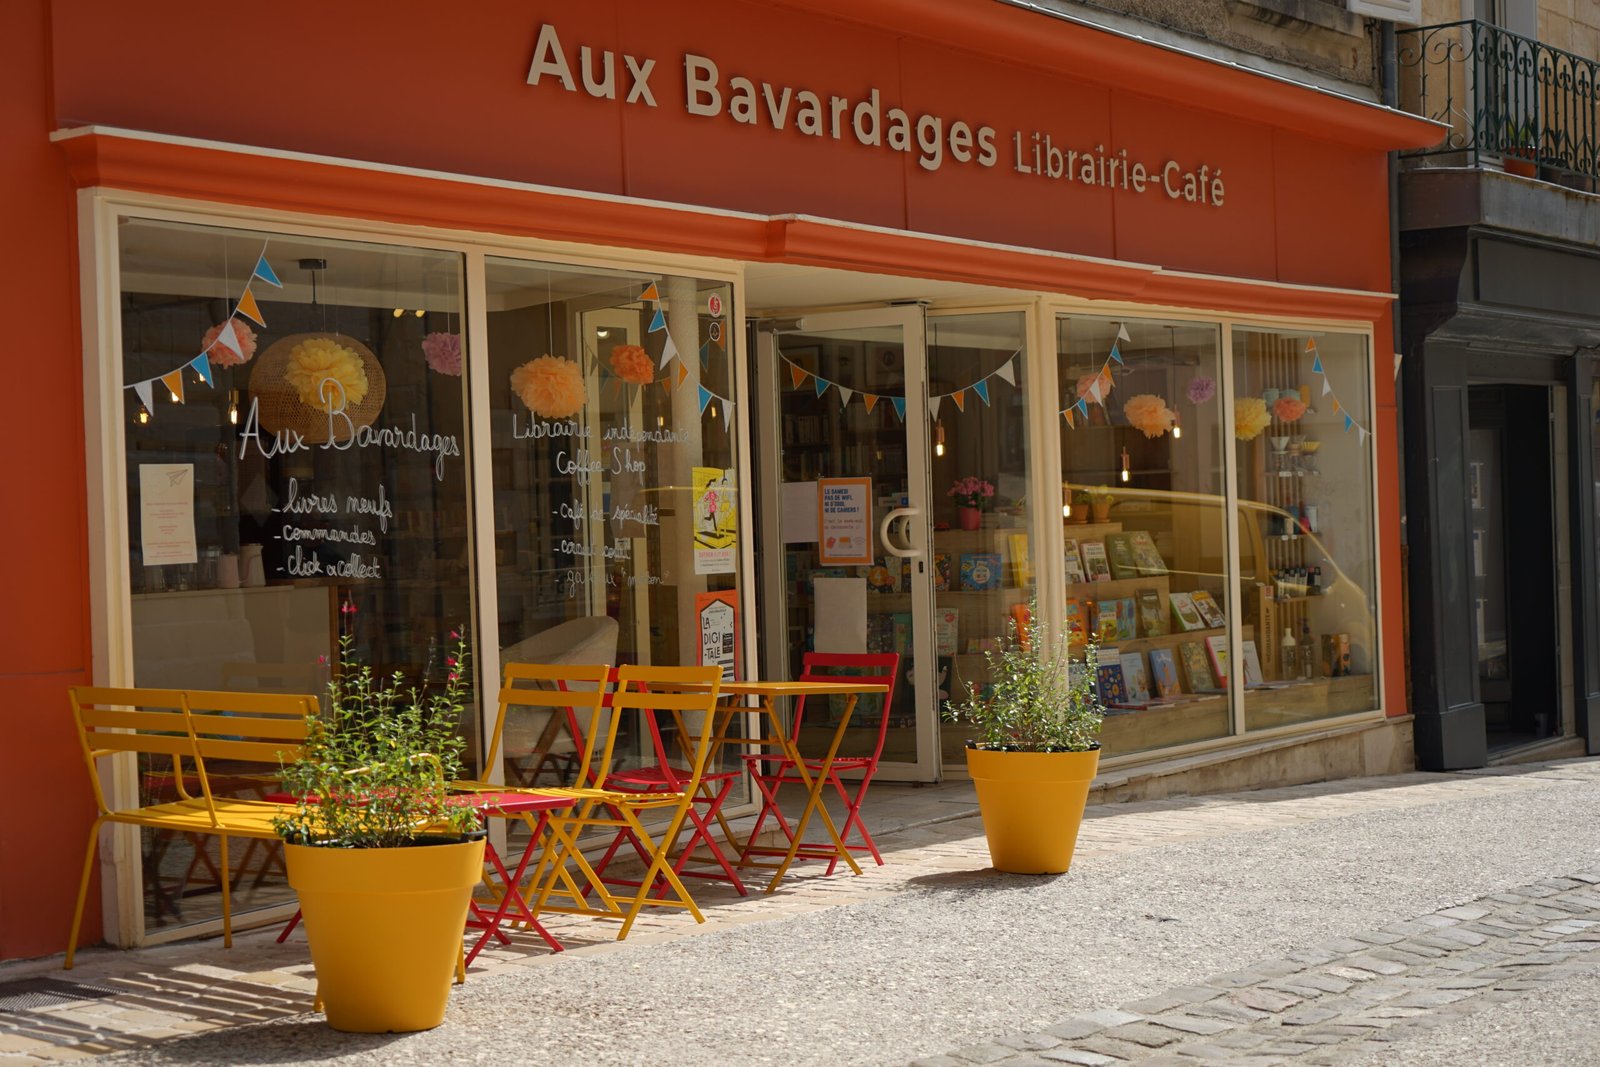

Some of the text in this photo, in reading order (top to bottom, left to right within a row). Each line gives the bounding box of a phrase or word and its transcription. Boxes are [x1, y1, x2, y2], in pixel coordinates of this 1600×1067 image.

[526, 23, 998, 172] Aux Bavardages
[1014, 130, 1225, 207] Librairie-Café
[239, 377, 460, 482] Aux Bavardages
[512, 410, 594, 440] Librairie
[556, 446, 646, 487] Coffee Shop
[345, 483, 392, 534] neufs
[702, 617, 711, 630] LA
[703, 631, 721, 646] DIGI
